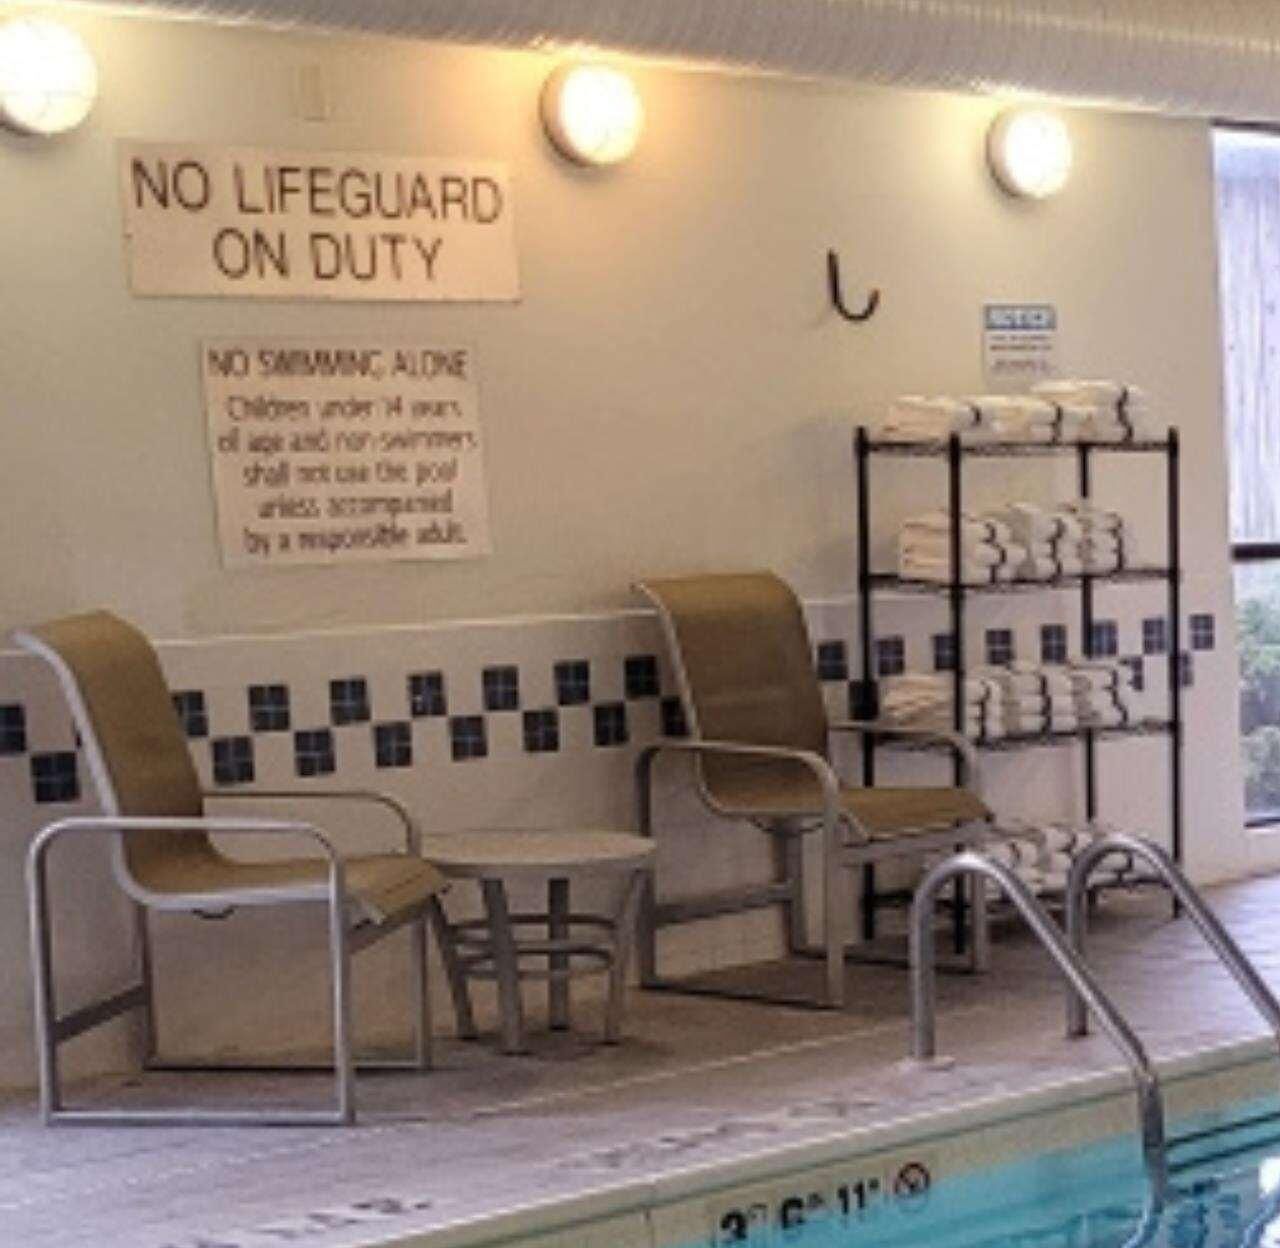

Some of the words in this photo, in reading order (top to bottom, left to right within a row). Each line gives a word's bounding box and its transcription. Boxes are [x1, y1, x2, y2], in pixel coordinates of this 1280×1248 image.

[131, 158, 210, 213] NO
[233, 166, 504, 225] LIFEGUARD
[212, 227, 289, 280] ON
[308, 232, 444, 281] DUTY
[208, 349, 249, 378] NO
[257, 350, 382, 379] SWIMMING
[392, 350, 467, 380] ALONE
[227, 396, 310, 420] Children
[320, 397, 373, 418] under
[290, 428, 330, 452] and
[243, 460, 290, 487] shall
[374, 460, 407, 483] the
[415, 457, 459, 486] pool
[258, 495, 321, 520] unless
[243, 527, 271, 557] by
